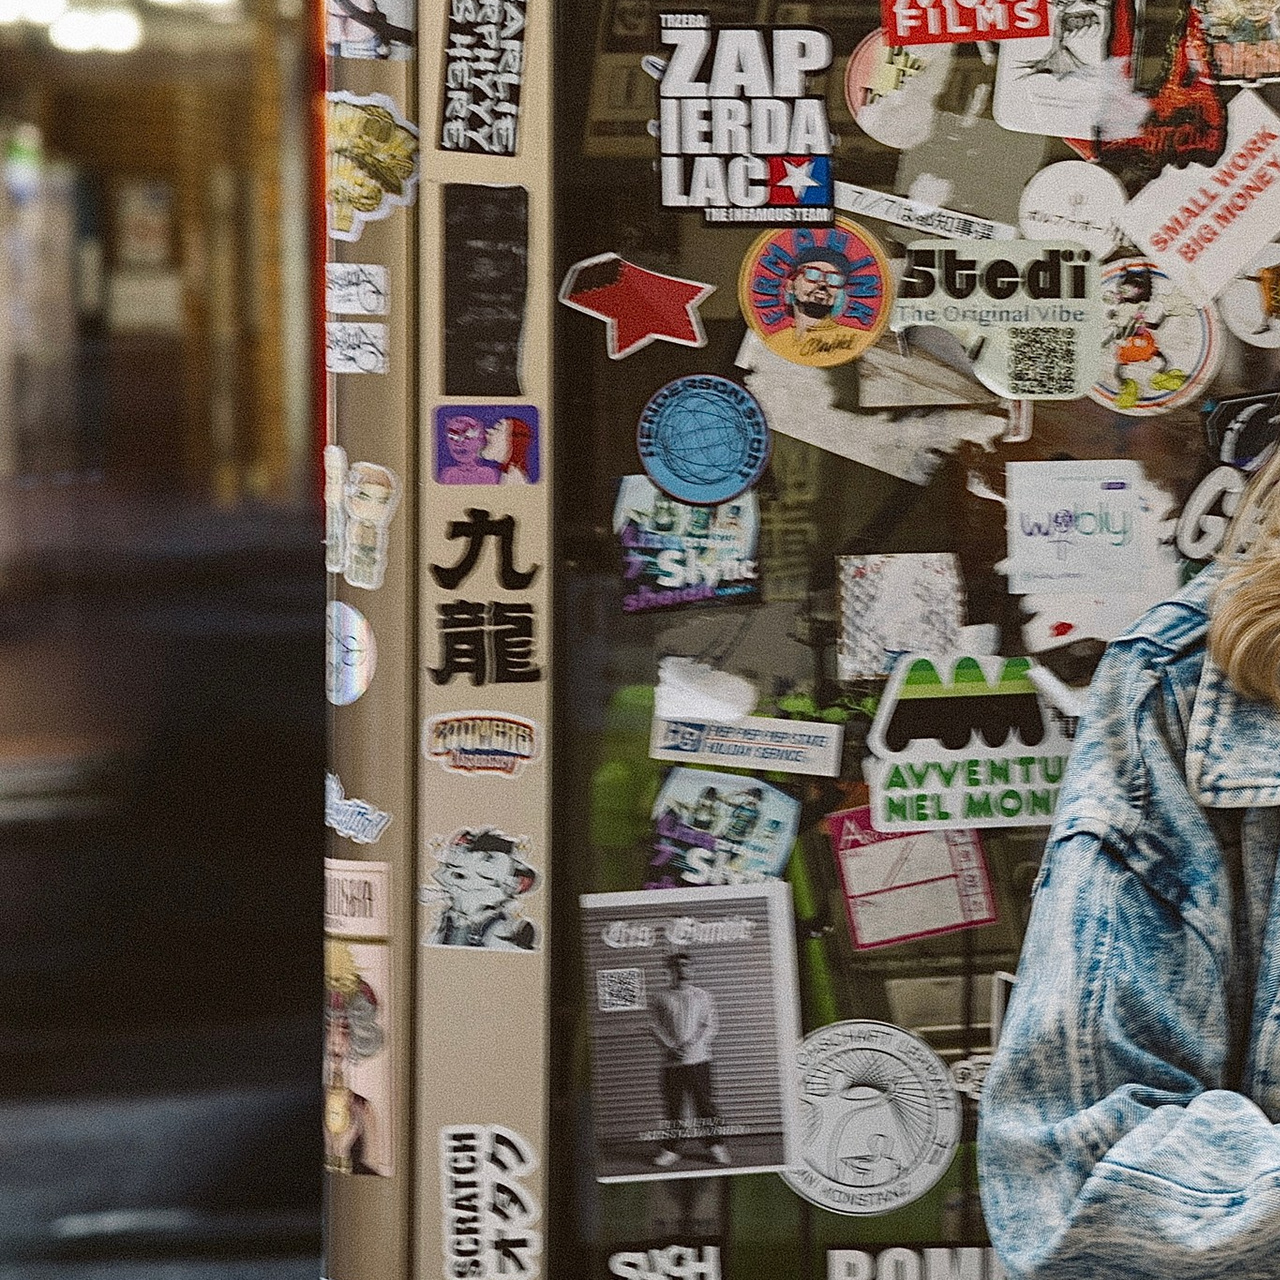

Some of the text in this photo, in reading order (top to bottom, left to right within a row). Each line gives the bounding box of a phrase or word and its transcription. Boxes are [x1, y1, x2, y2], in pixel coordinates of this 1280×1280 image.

[892, 0, 1042, 38] FILMS
[441, 31, 477, 150] HERE
[660, 29, 833, 97] ZAP
[660, 98, 834, 155] IERDA
[1150, 185, 1222, 253] SMALL
[1210, 122, 1280, 189] WORK
[1175, 222, 1222, 265] BIG
[898, 304, 1084, 325] The Original Vibe
[641, 377, 748, 458] HENDERSON
[428, 507, 542, 687] 九龍
[887, 795, 948, 821] NEL
[452, 1131, 479, 1280] SCRATCH
